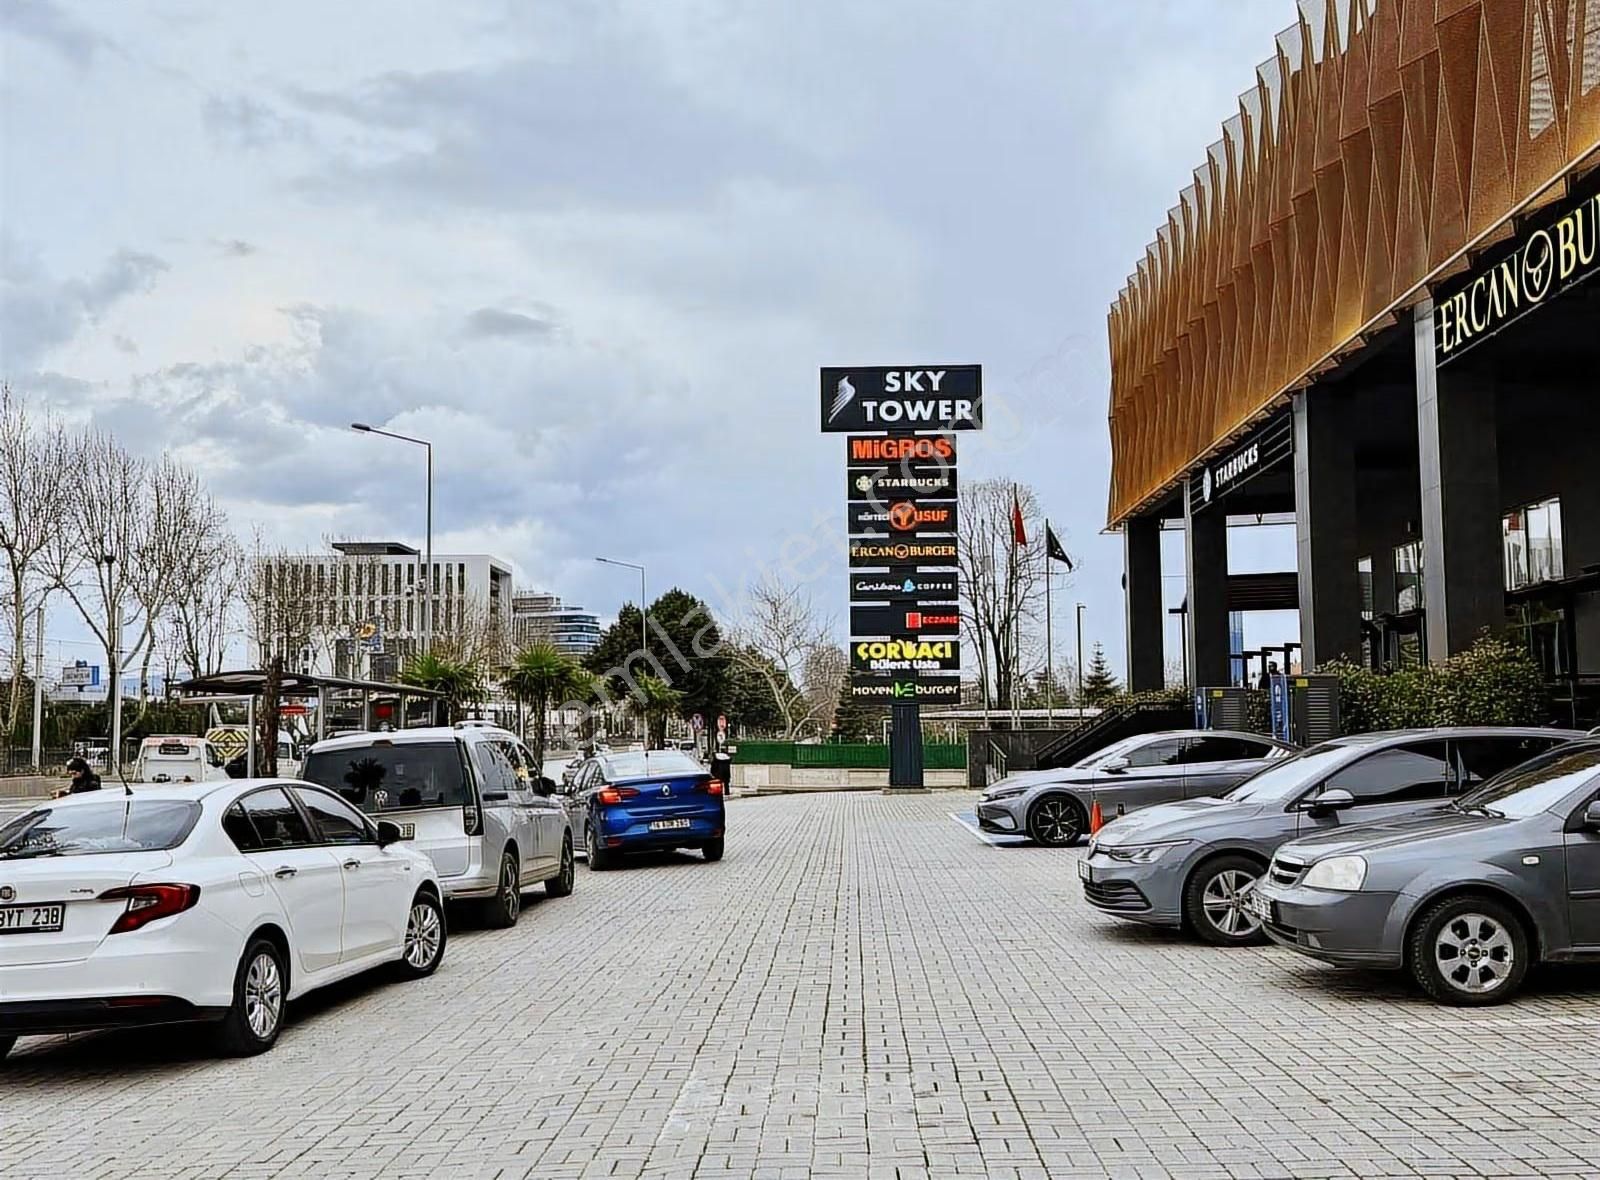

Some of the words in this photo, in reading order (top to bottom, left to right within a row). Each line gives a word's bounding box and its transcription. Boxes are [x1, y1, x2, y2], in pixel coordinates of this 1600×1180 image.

[1440, 253, 1518, 353] ERCAN
[1557, 194, 1600, 280] BU
[885, 371, 946, 392] SKY
[862, 400, 973, 422] TOWER
[1215, 443, 1258, 489] STARBUCKS
[877, 477, 949, 487] STARBUCKS
[852, 546, 895, 557] ERCAN
[910, 546, 956, 556] BURGER
[32, 907, 60, 925] 238
